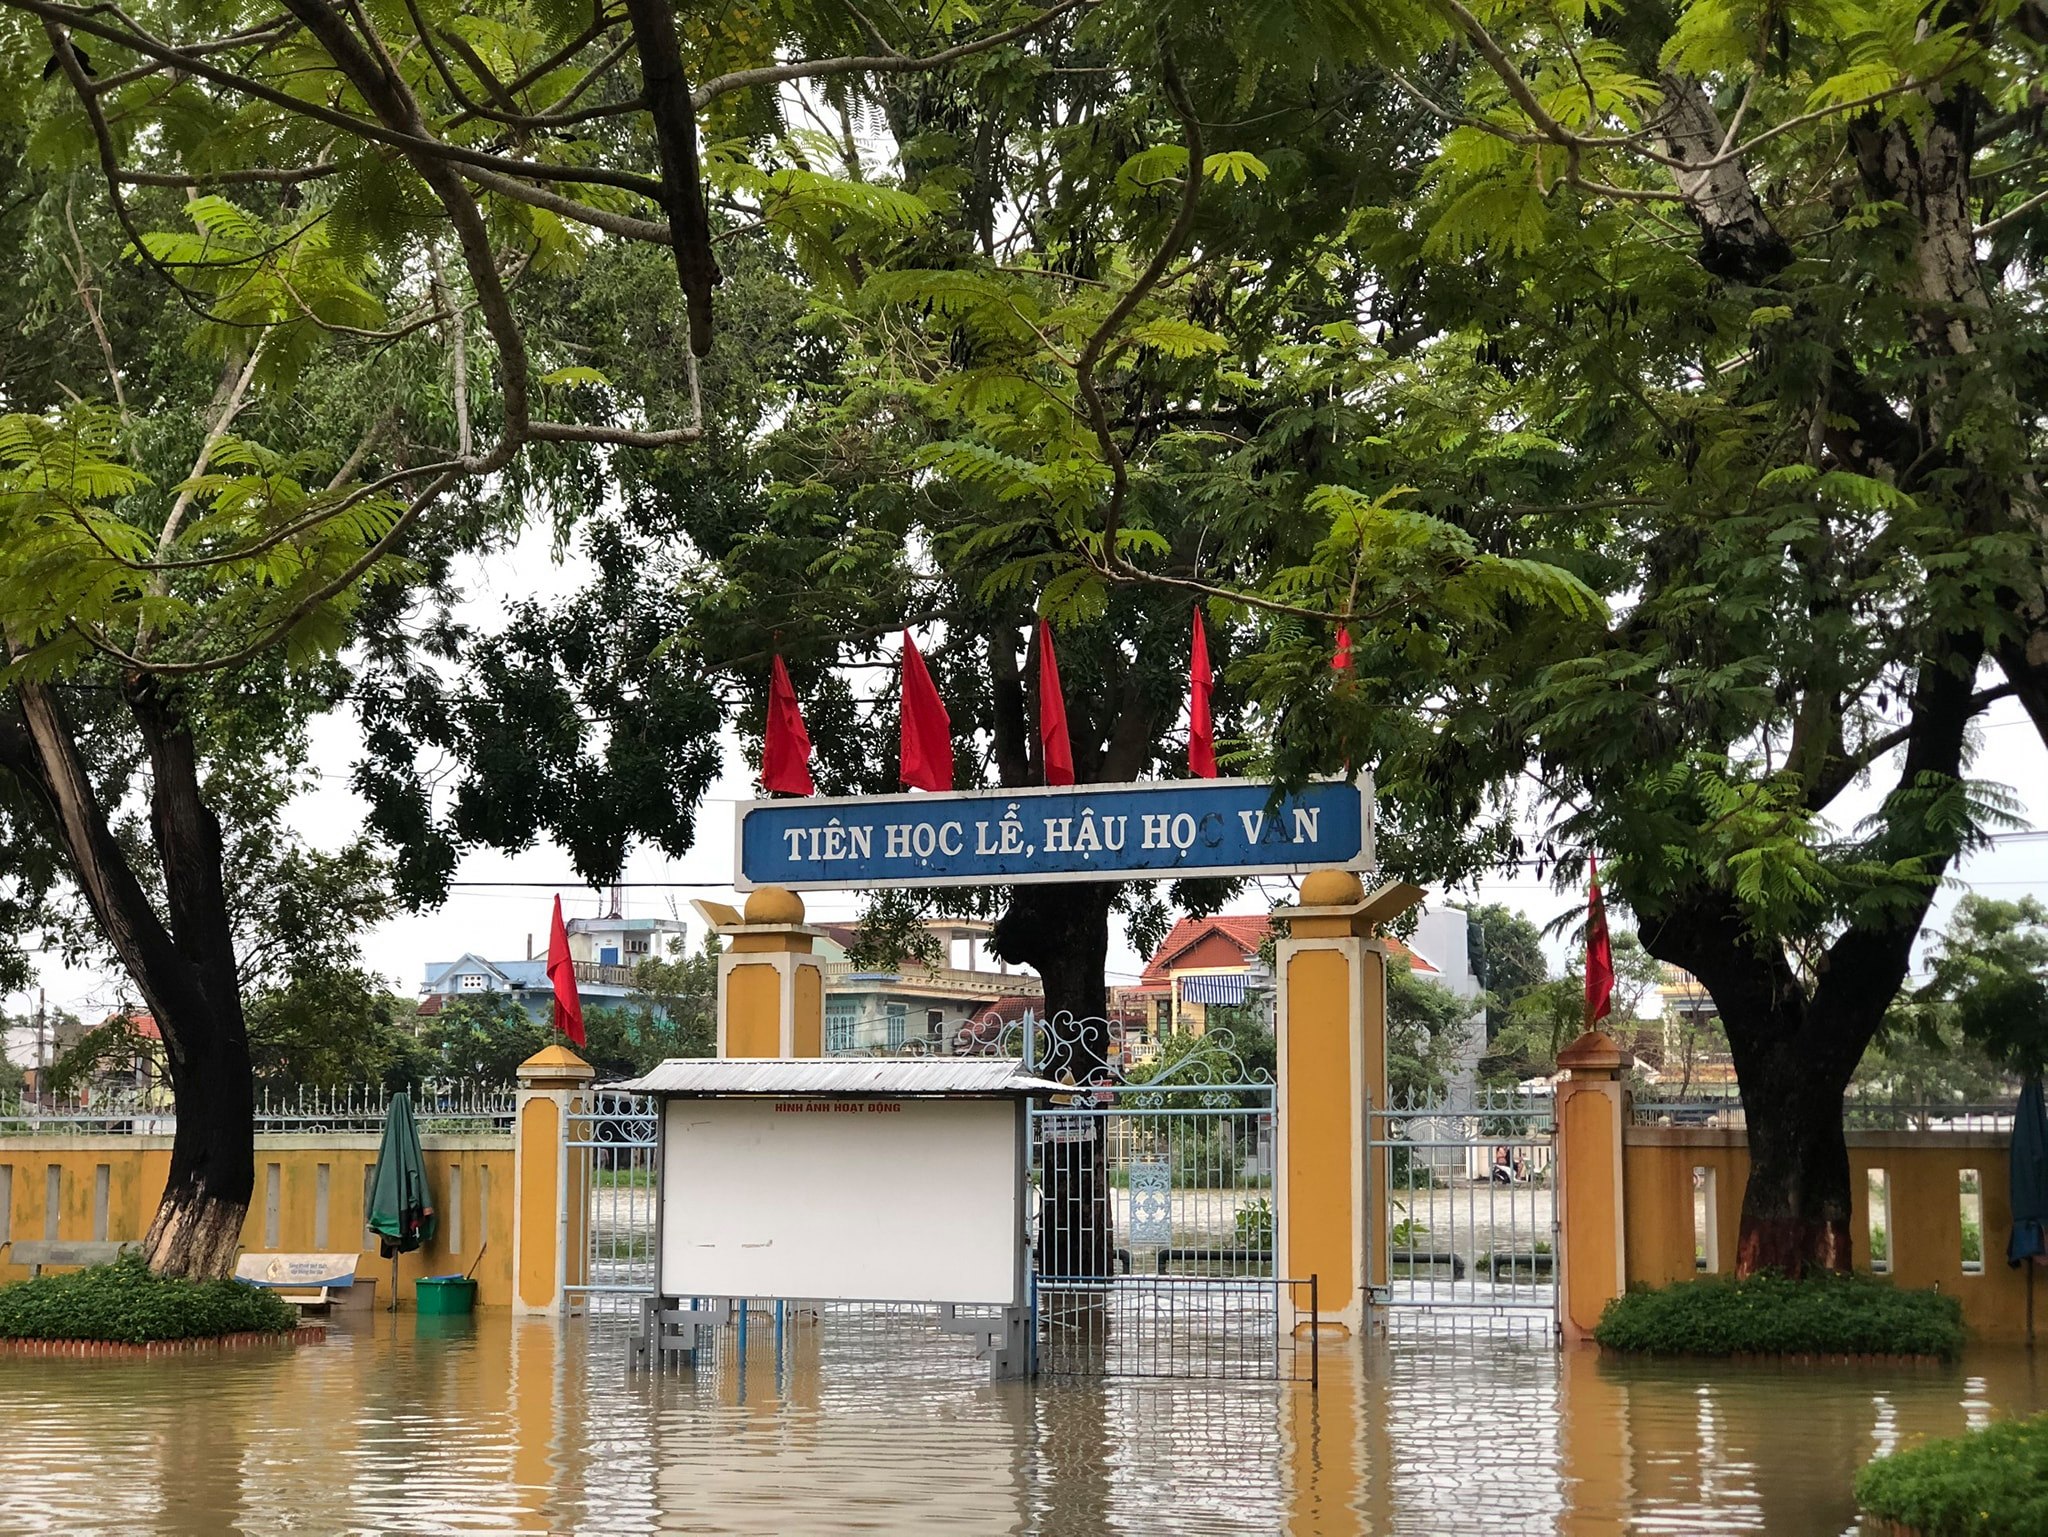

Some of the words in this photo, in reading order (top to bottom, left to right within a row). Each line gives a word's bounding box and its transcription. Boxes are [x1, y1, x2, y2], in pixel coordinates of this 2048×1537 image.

[783, 816, 873, 861] TIÊN
[884, 821, 963, 866] HỌC
[975, 802, 1034, 858] LỄ,
[1043, 807, 1128, 860] HẬU
[834, 1103, 864, 1115] HOẠT
